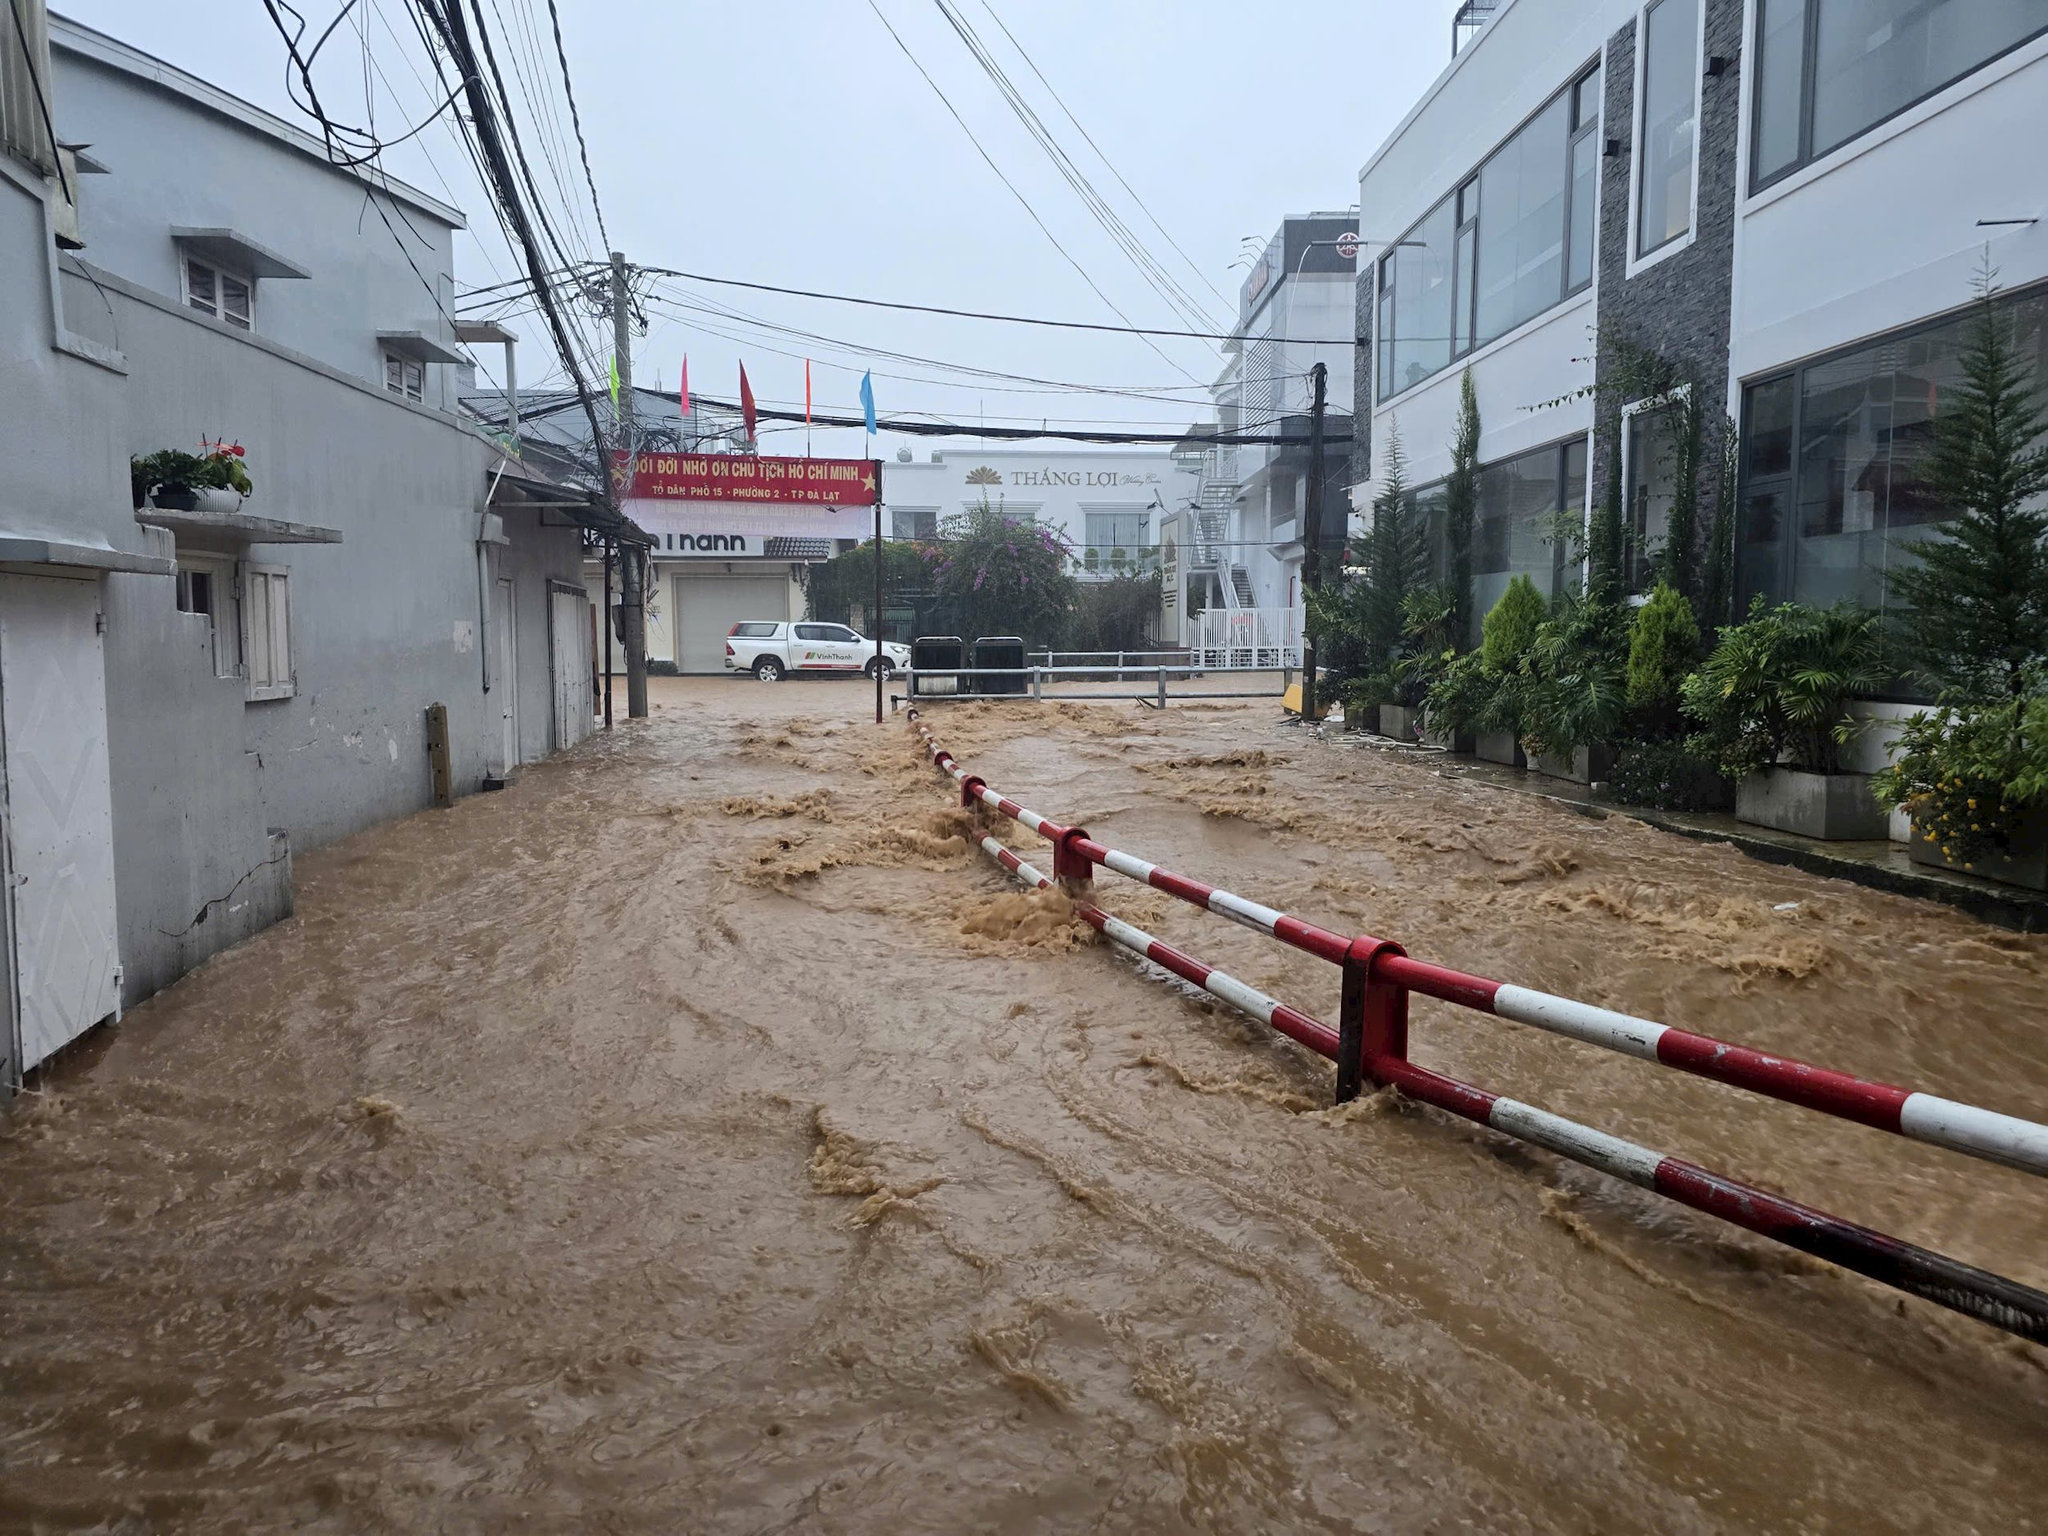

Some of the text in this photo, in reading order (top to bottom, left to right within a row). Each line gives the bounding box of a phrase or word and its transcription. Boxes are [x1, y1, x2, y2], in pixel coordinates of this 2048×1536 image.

[657, 456, 678, 475] ĐỜI
[712, 460, 729, 477] ƠN
[732, 456, 755, 477] CHỦ
[758, 462, 785, 482] TỊCH
[788, 459, 804, 480] HỒ
[808, 462, 828, 480] CHÍ
[830, 465, 859, 481] MINH
[1011, 467, 1081, 486] THẮNG
[1086, 471, 1118, 488] LỢI
[667, 484, 686, 495] DÂN
[713, 487, 723, 497] 15
[732, 485, 771, 498] PHƯỜNG
[773, 489, 780, 499] 2
[791, 490, 805, 499] TP
[823, 491, 840, 502] LẠT
